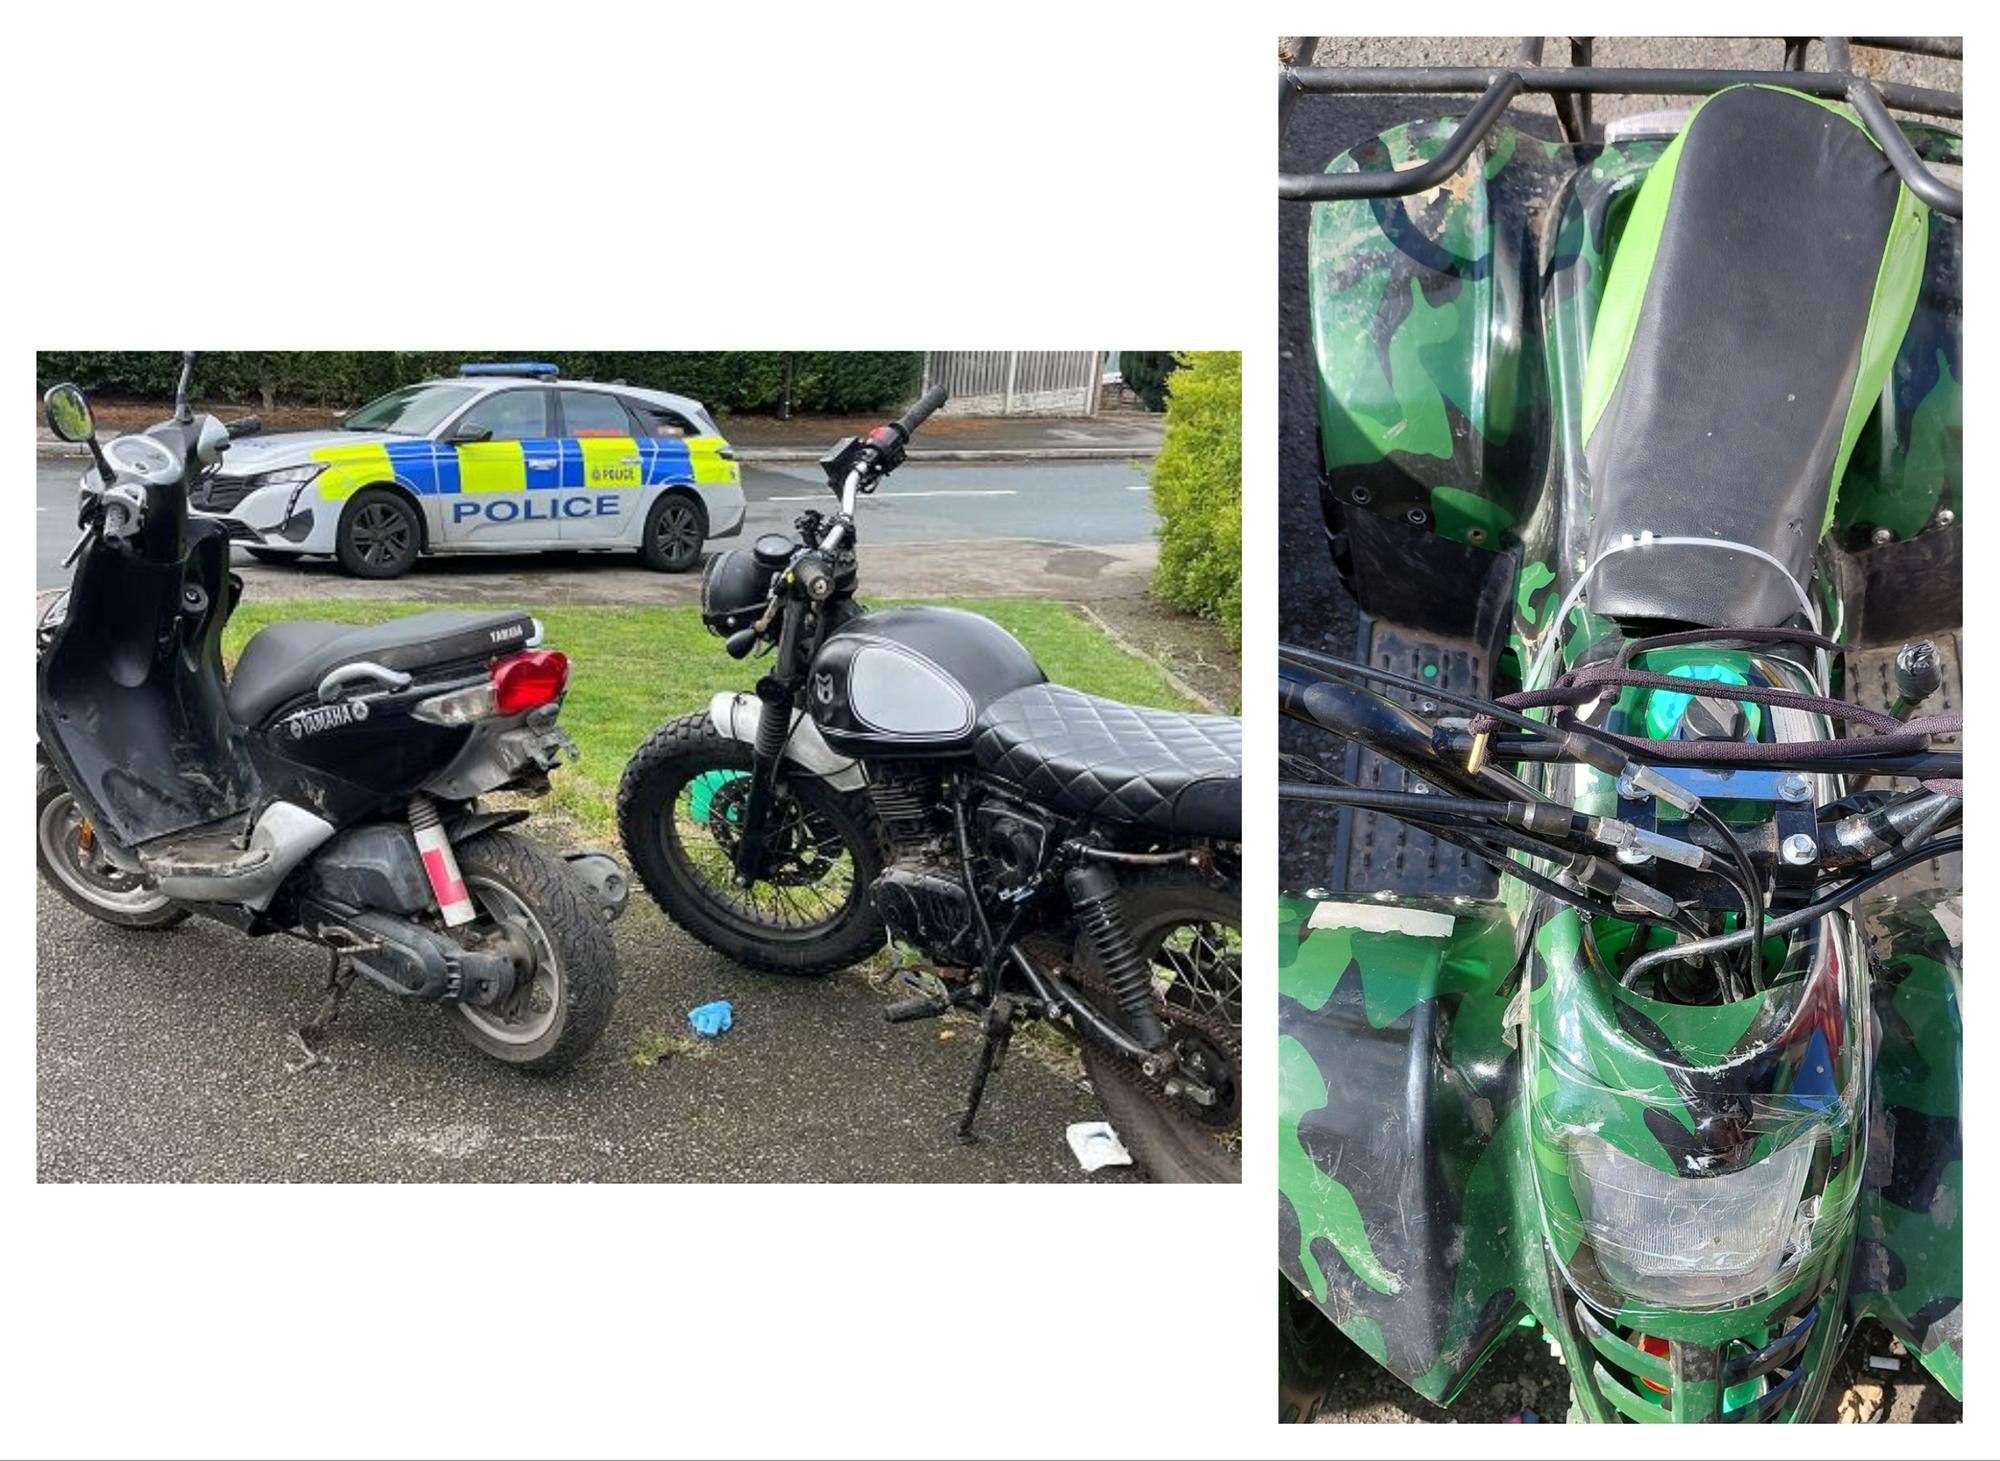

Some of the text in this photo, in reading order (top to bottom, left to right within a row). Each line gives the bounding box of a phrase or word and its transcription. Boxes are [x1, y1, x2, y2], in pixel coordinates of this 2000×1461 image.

[602, 467, 634, 481] POLICE
[453, 495, 620, 523] POLICE
[490, 624, 523, 643] YAMAHA
[301, 704, 353, 736] YAMAHA
